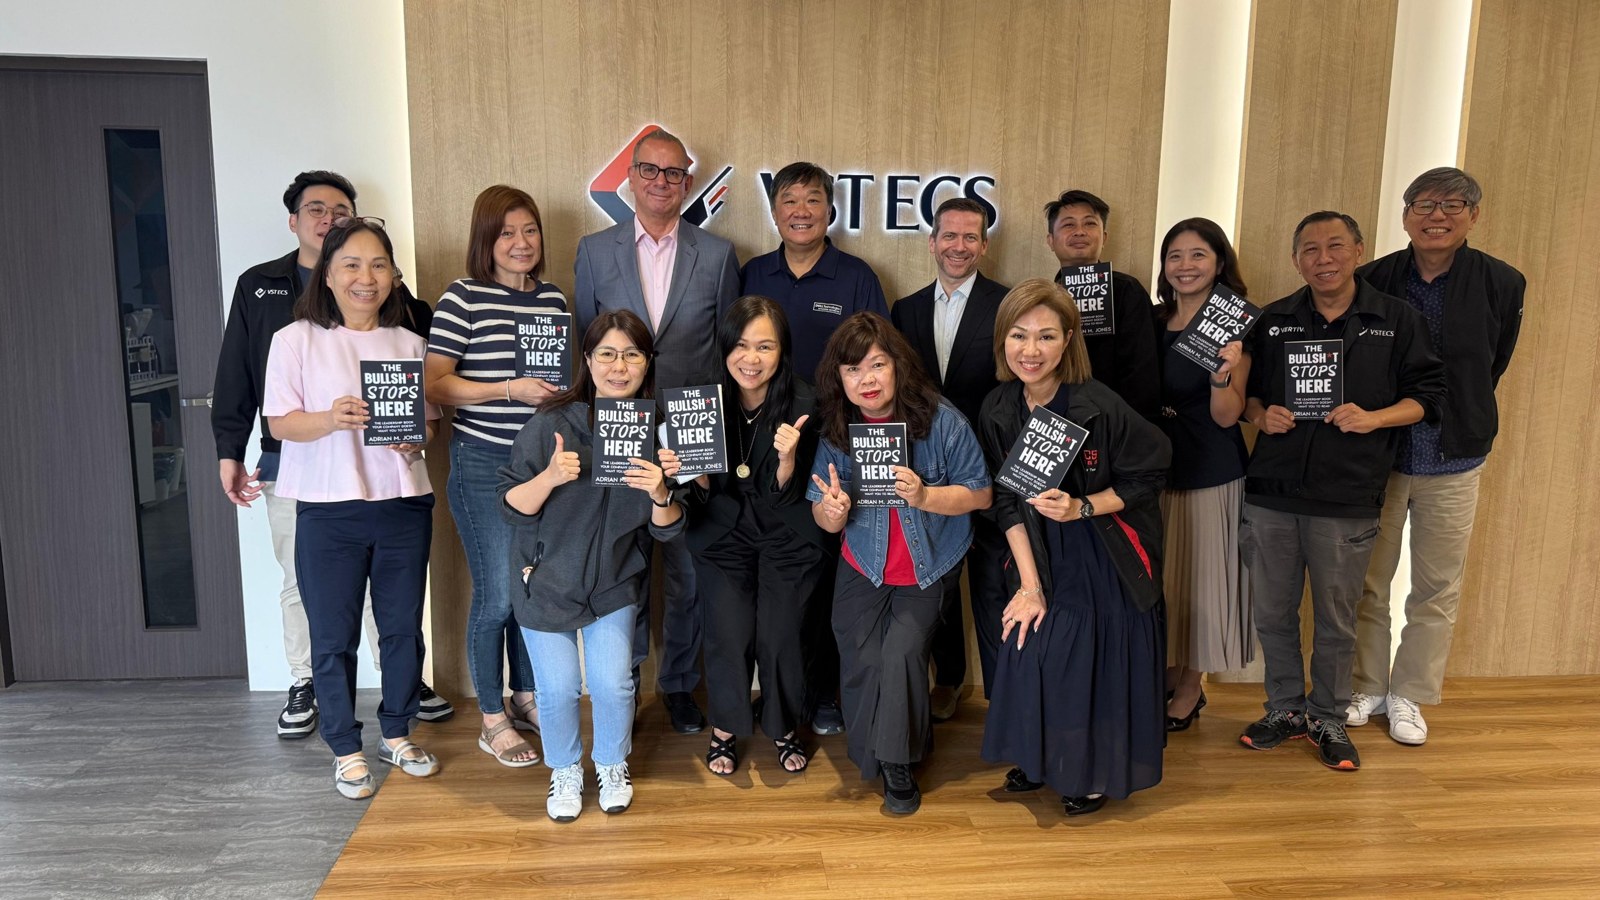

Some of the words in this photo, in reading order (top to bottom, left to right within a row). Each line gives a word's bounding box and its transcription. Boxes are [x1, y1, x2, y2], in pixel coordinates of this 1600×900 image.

[886, 175, 996, 230] ECS
[1068, 284, 1108, 297] STOPS
[1230, 295, 1246, 308] THE
[1203, 306, 1245, 334] STOPS
[1197, 319, 1232, 345] HERE
[521, 337, 566, 350] STOPS
[526, 351, 561, 366] HERE
[1177, 343, 1195, 355] ADRIAN
[1202, 357, 1218, 368] JONES
[1291, 365, 1337, 377] STOPS
[368, 386, 418, 399] STOPS
[1296, 379, 1332, 393] HERE
[683, 390, 700, 398] THE
[374, 401, 414, 416] HERE
[671, 411, 716, 427] STOPS
[1050, 417, 1067, 431] THE
[599, 424, 648, 439] STOPS
[678, 427, 714, 445] HERE
[604, 440, 642, 456] HERE
[1024, 432, 1069, 462] STOPS
[856, 450, 900, 462] STOPS
[1019, 447, 1057, 476] HERE
[1000, 476, 1021, 488] ADRIAN
